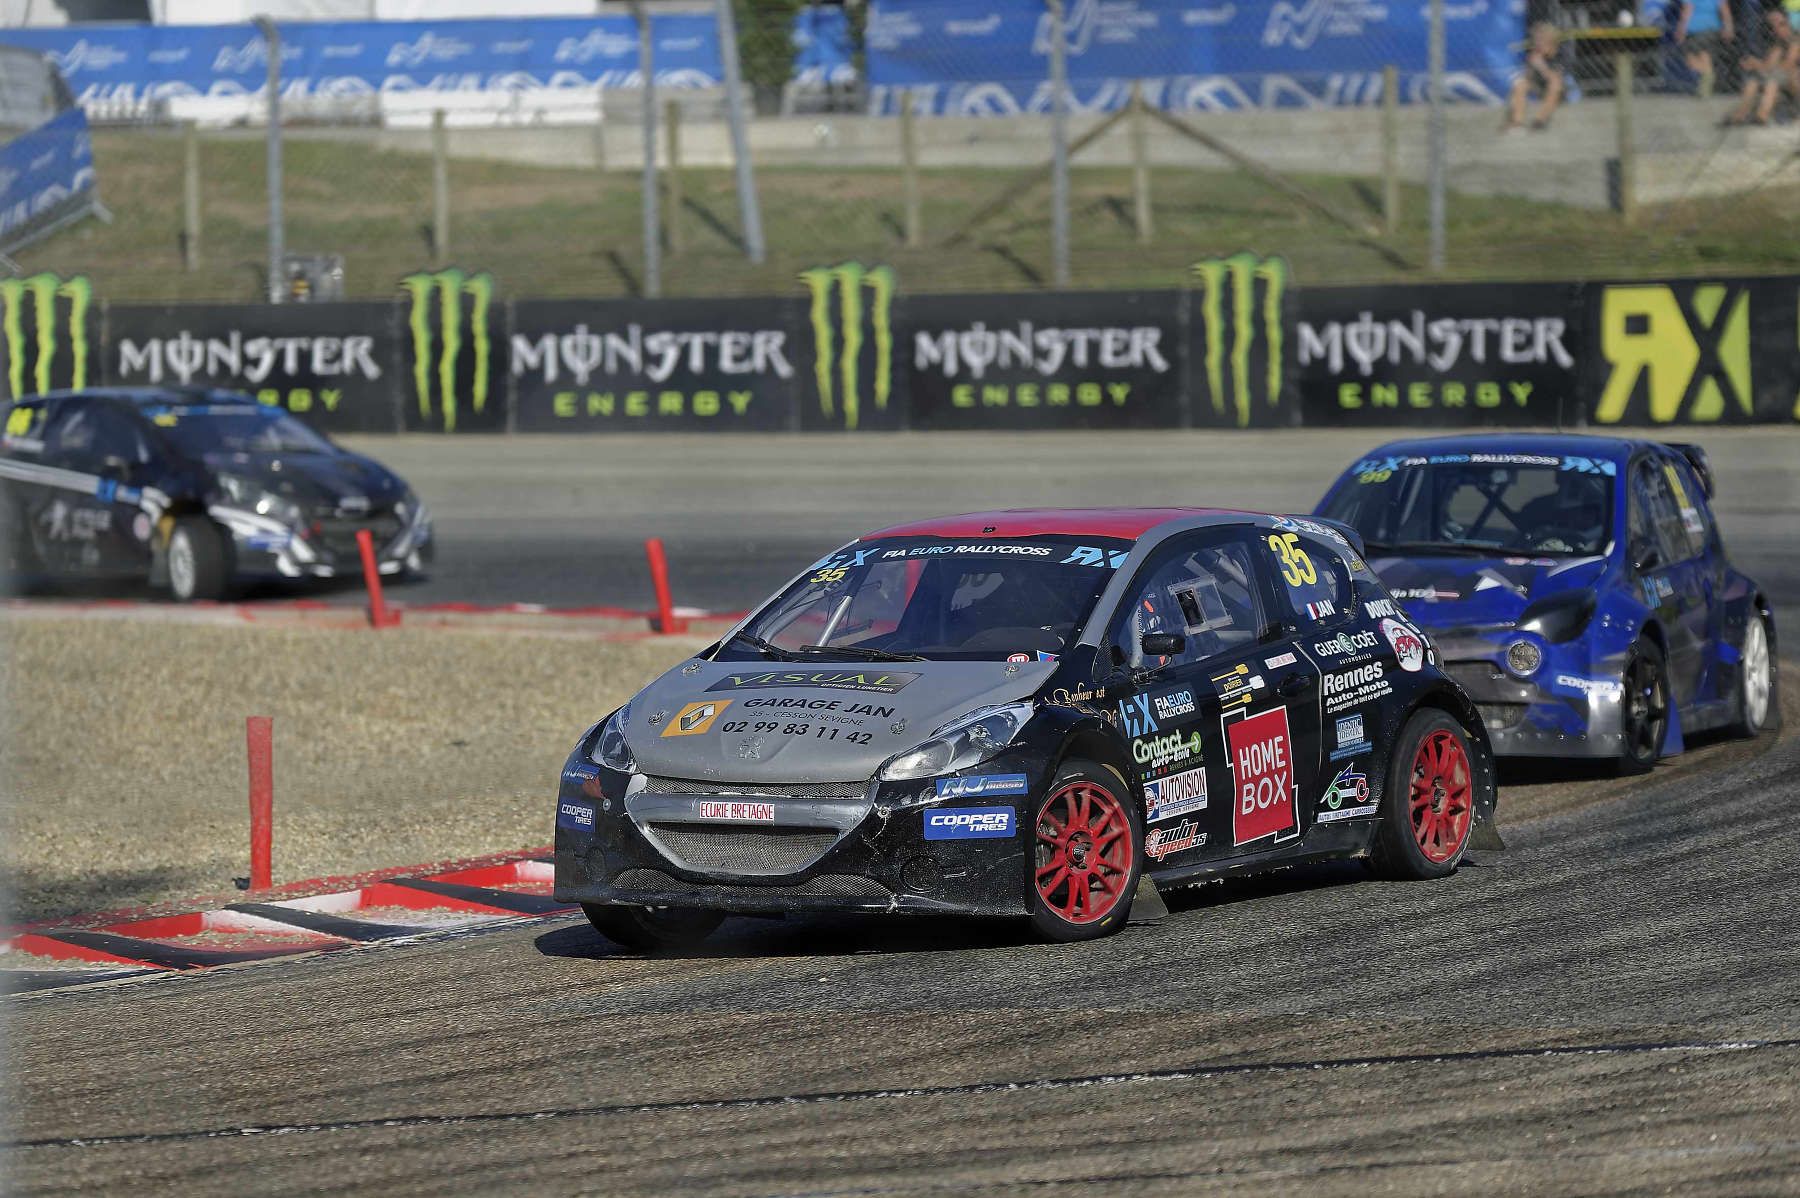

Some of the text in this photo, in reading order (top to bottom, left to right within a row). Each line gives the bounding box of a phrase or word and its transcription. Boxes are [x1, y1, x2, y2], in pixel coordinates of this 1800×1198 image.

[510, 322, 794, 385] MONSTER
[914, 319, 1170, 378] MONSTER
[1296, 309, 1574, 376] MONSTER
[119, 330, 382, 385] MONSTER
[552, 389, 753, 417] ENERGY
[951, 382, 1131, 408] ENERGY
[1337, 380, 1534, 408] ENERGY
[881, 550, 905, 559] FIA
[907, 547, 953, 556] EURO
[953, 546, 1052, 556] RALLYCROSS
[1268, 532, 1317, 587] 35
[810, 566, 850, 583] 35
[1316, 600, 1336, 618] JAN
[729, 673, 901, 686] VISUAL
[1323, 661, 1383, 696] Rennes
[1326, 680, 1389, 707] Auto-Moto
[743, 698, 895, 718] GARAGE JAN
[773, 711, 818, 719] CESSON
[1158, 701, 1196, 720] RALLYCROSS
[722, 721, 873, 746] 02 99 83 11 42
[1132, 729, 1183, 764] Contact
[1239, 735, 1286, 780] HOME
[1160, 770, 1206, 806] AUTOVISION
[1241, 771, 1287, 815] BOX
[561, 803, 593, 819] COOPER
[701, 802, 774, 822] ECURIE BRETAGNE
[930, 813, 1009, 826] COOPER
[968, 823, 1007, 832] TIRES
